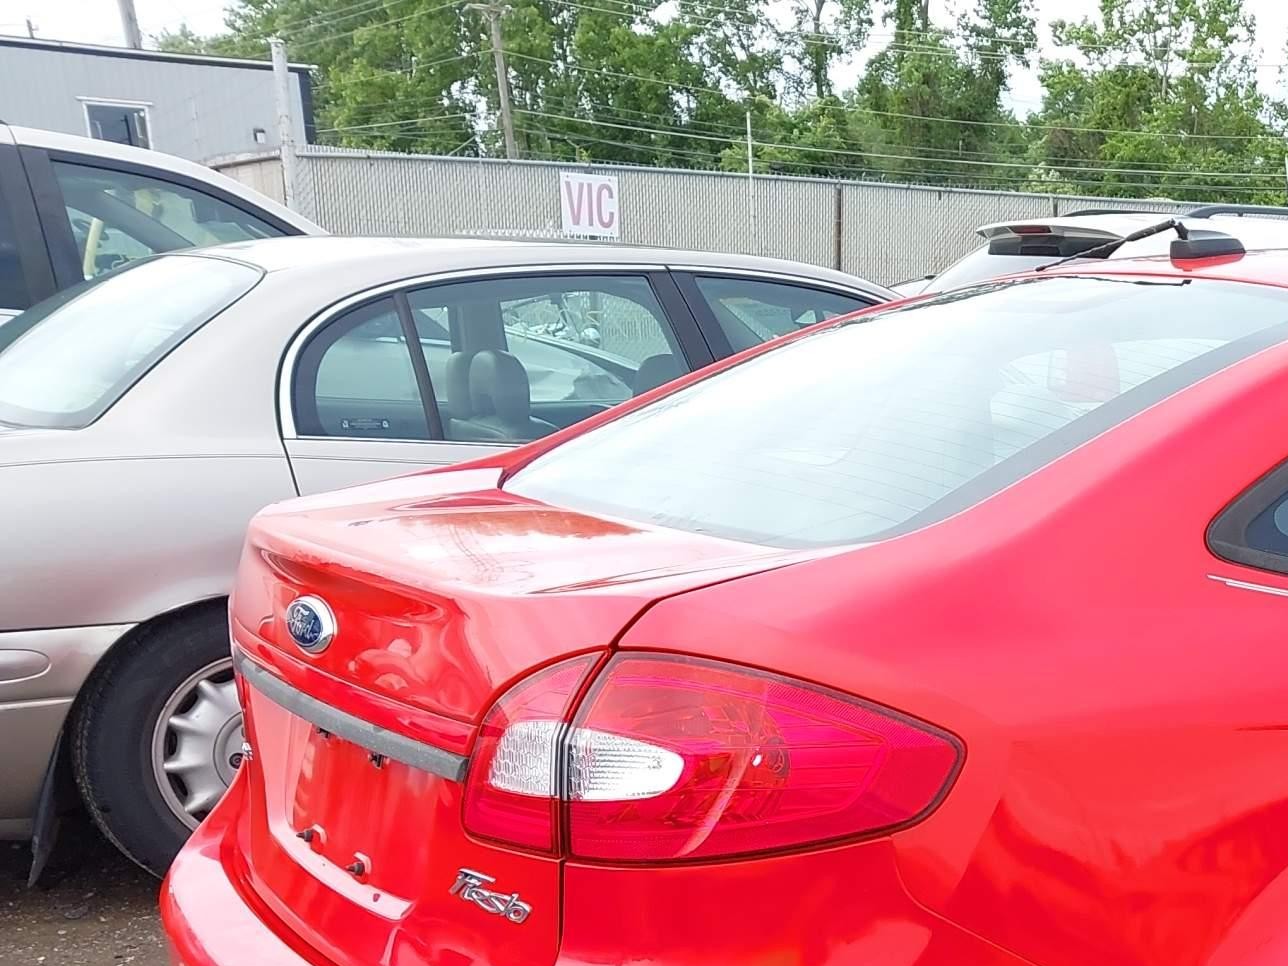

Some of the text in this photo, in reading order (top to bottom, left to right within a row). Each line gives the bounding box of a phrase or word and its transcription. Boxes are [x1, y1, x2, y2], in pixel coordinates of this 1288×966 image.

[564, 180, 615, 229] VIC
[288, 605, 322, 640] Ford
[448, 867, 533, 924] Fiesta
